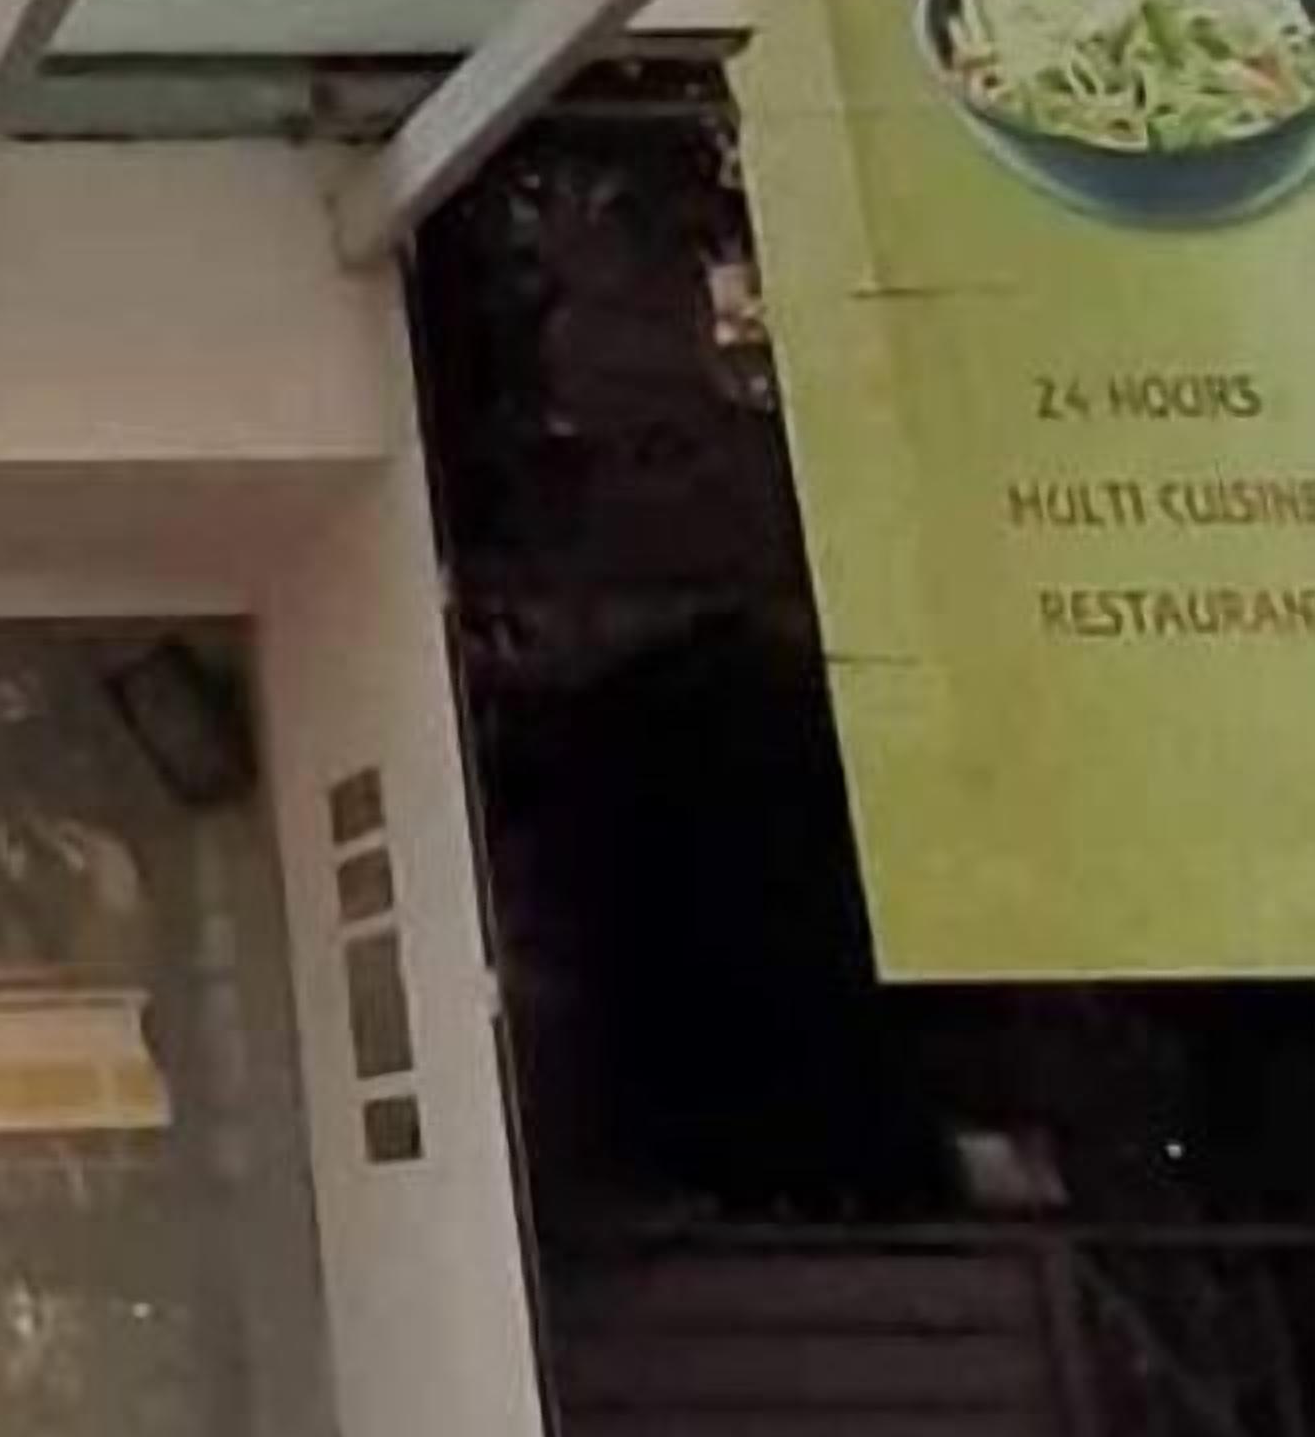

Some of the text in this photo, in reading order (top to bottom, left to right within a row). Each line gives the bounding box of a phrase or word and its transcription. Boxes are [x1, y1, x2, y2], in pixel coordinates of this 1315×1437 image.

[1033, 374, 1263, 420] 24 HOURS
[1007, 481, 1146, 525] MULTI
